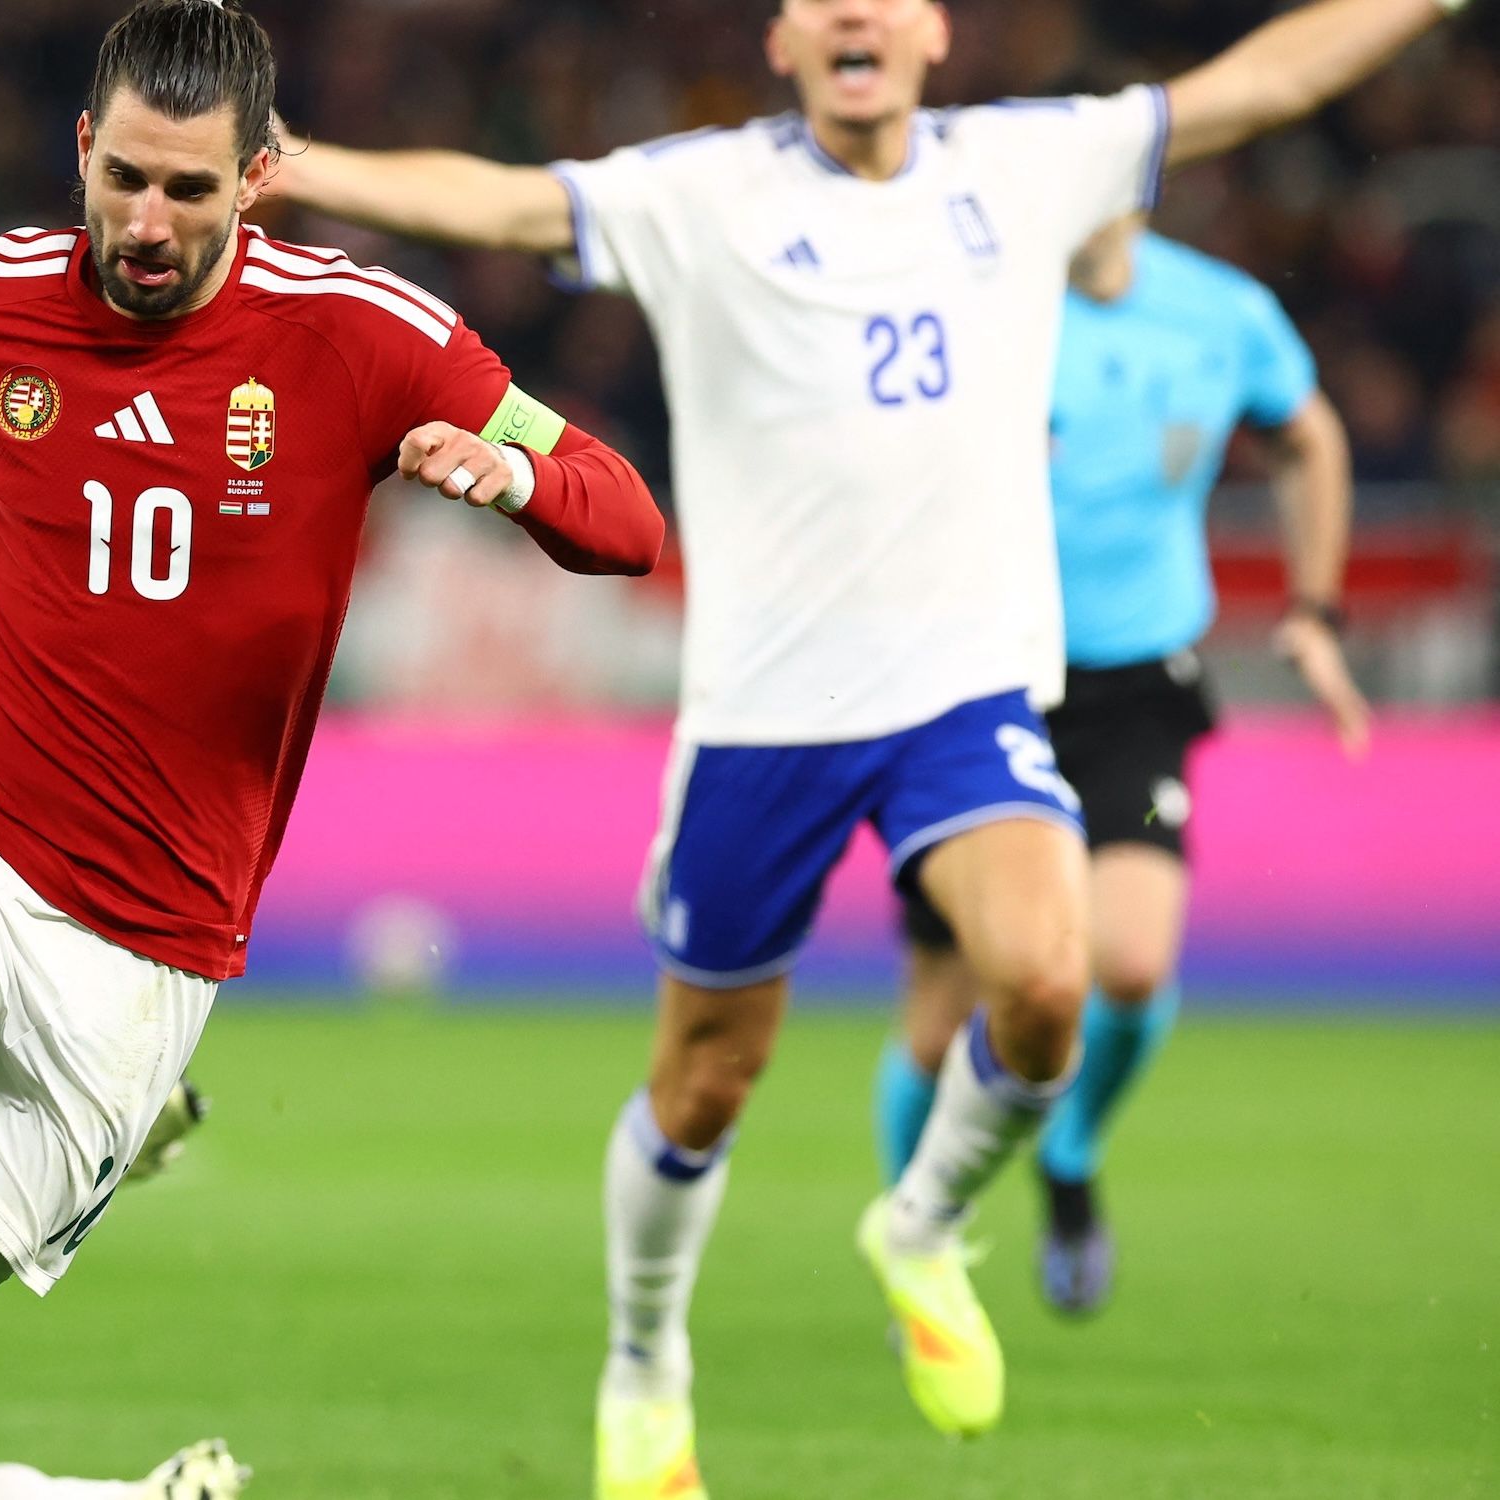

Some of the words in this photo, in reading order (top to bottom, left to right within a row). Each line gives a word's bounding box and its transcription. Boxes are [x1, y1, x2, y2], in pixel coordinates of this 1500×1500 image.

[864, 312, 950, 407] 23
[227, 479, 264, 487] 31.03.2026
[82, 479, 193, 601] 10
[994, 723, 1082, 812] 2
